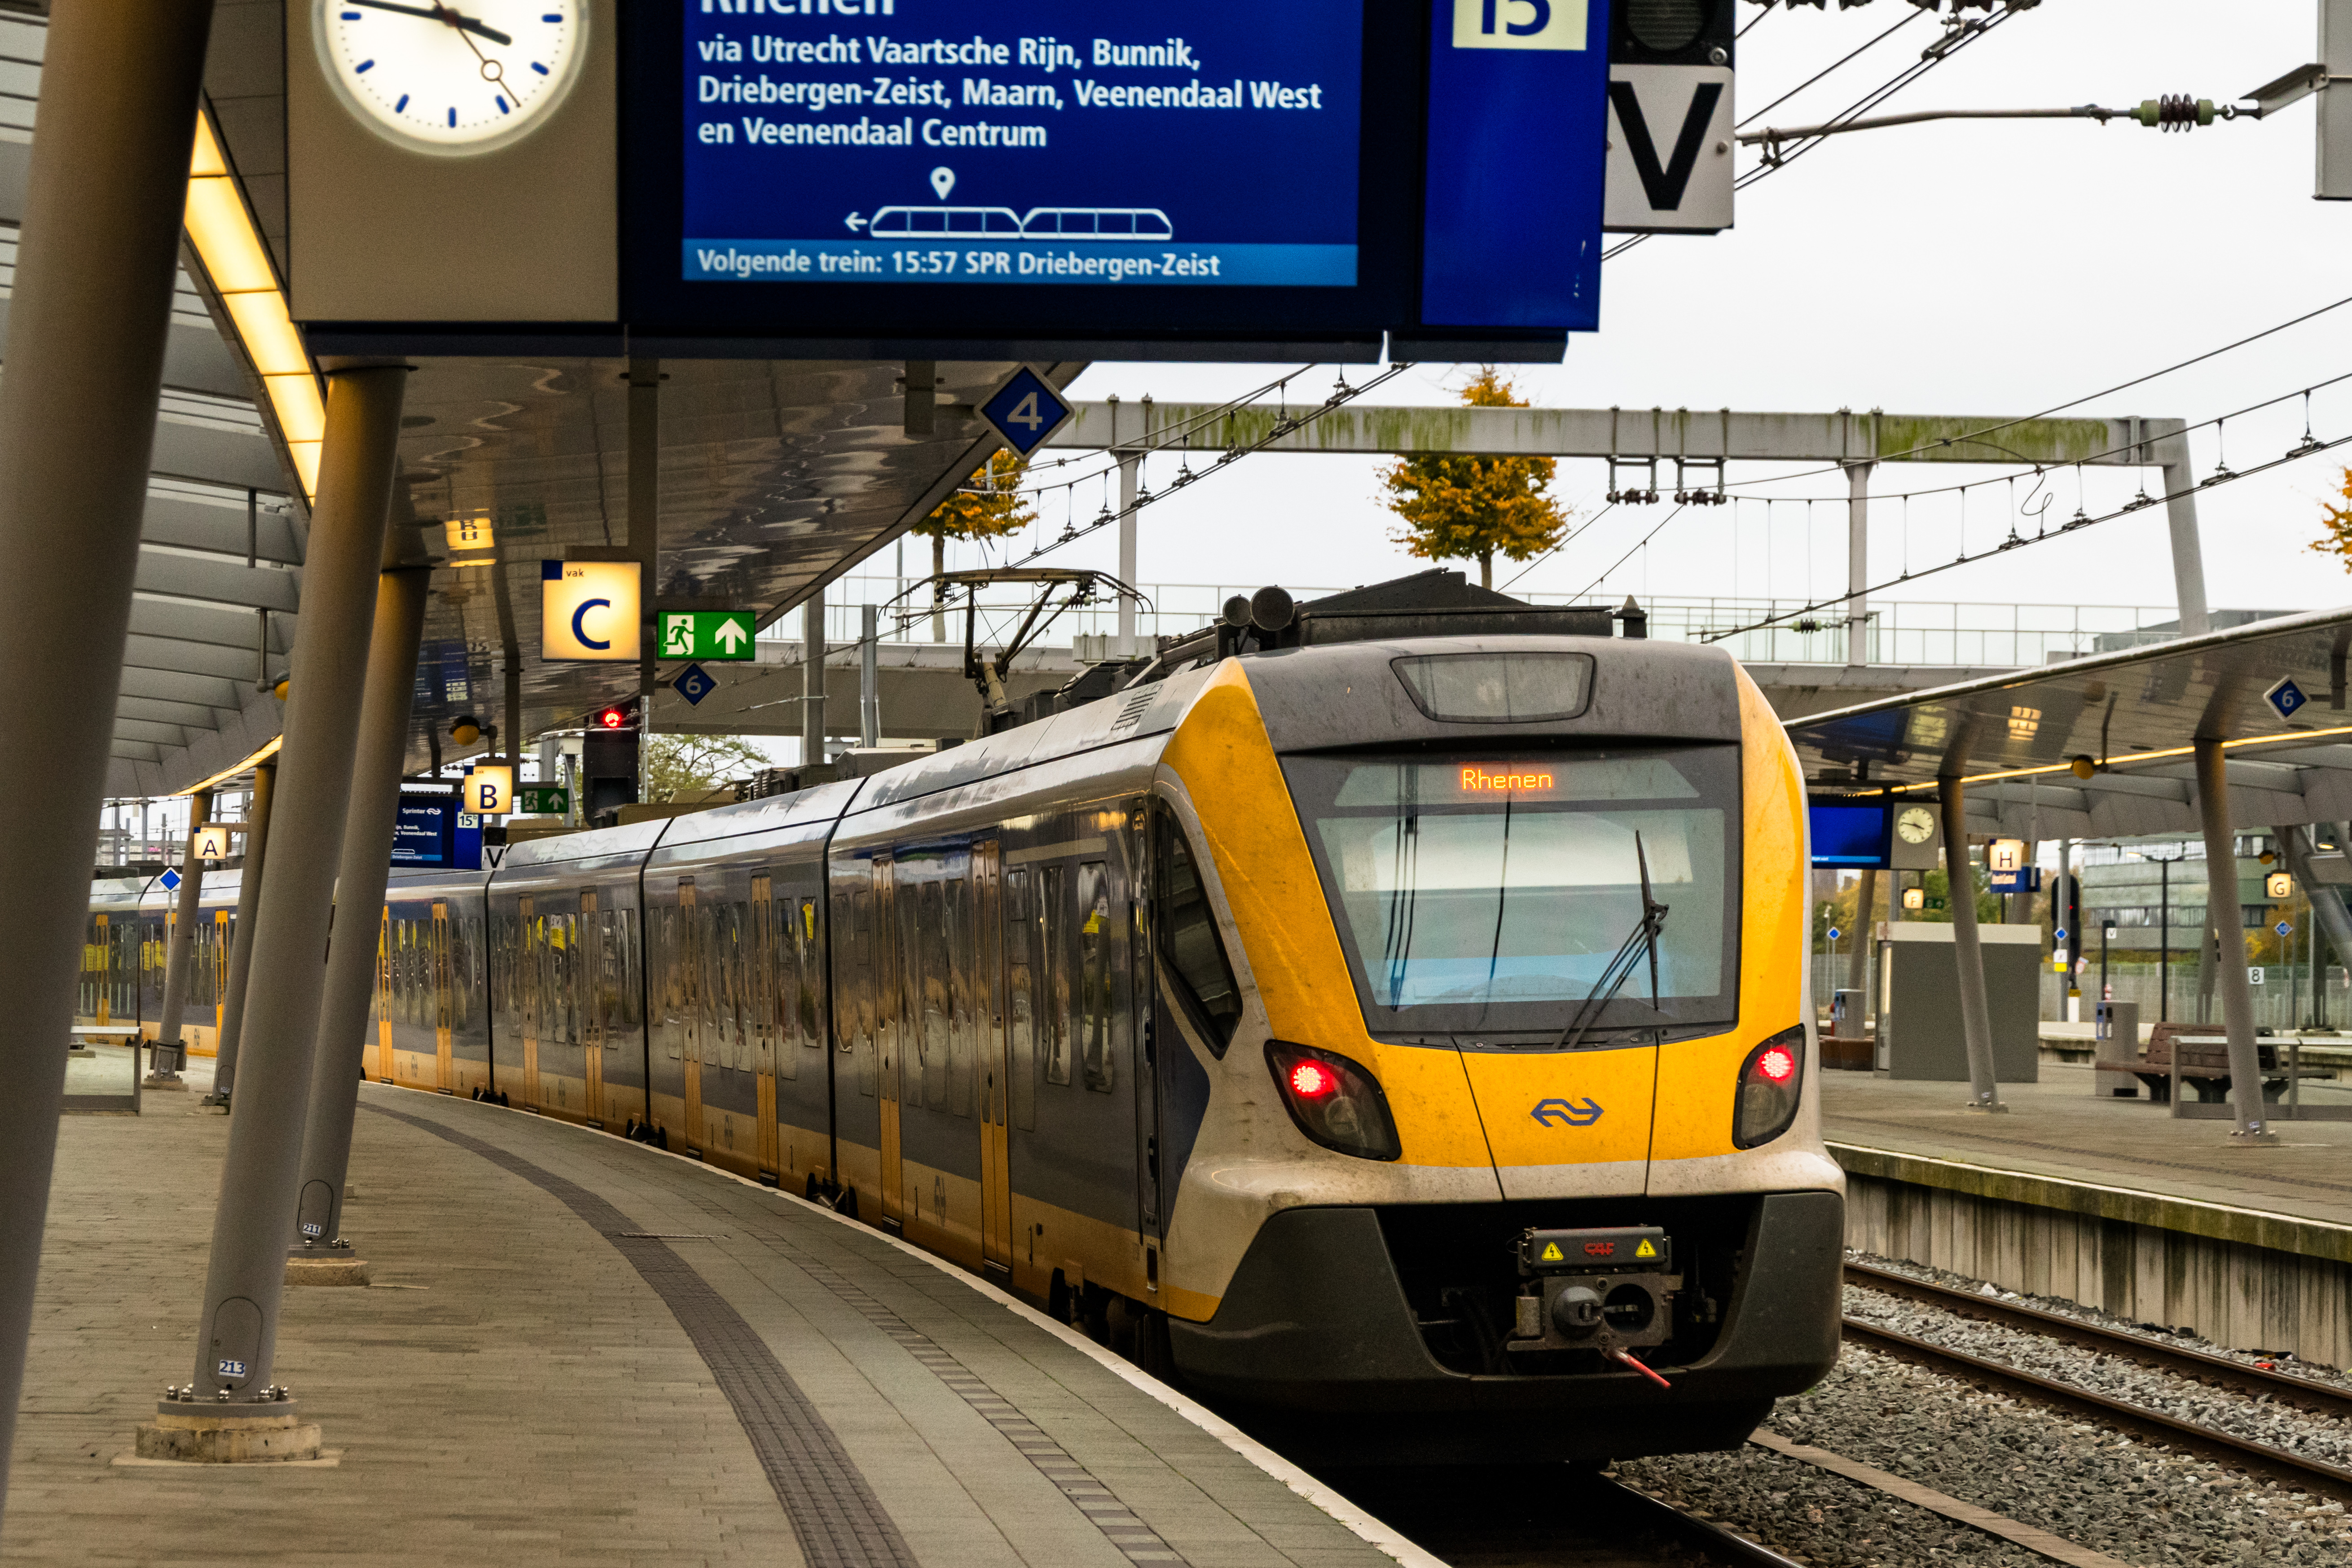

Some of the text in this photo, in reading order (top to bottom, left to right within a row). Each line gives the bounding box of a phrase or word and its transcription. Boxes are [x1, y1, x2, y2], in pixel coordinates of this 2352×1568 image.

[698, 33, 1200, 72] via Utrecht Vaartsche Rijn, Bunnik,
[699, 75, 1322, 111] Driebergen-Zeist, Maarn, Veenendaal West
[699, 116, 1046, 146] en Veenendaal Centrum
[1610, 81, 1724, 211] V
[697, 248, 1220, 281] Volgende trein: 15:57 SPR Driebergen-Zeist
[1007, 392, 1043, 431] 4
[566, 568, 584, 577] vak
[572, 598, 611, 650] C
[686, 675, 701, 694] 6
[2282, 690, 2294, 707] 6
[1462, 769, 1552, 790] Rhenen
[479, 784, 497, 809] B
[202, 839, 218, 856] A
[486, 848, 504, 868] V
[2000, 852, 2013, 868] H
[2274, 882, 2285, 895] G
[1911, 896, 1917, 906] F
[2252, 969, 2260, 982] 8
[303, 1224, 319, 1234] 211
[1584, 1242, 1614, 1256] CAF
[220, 1361, 245, 1375] 213
